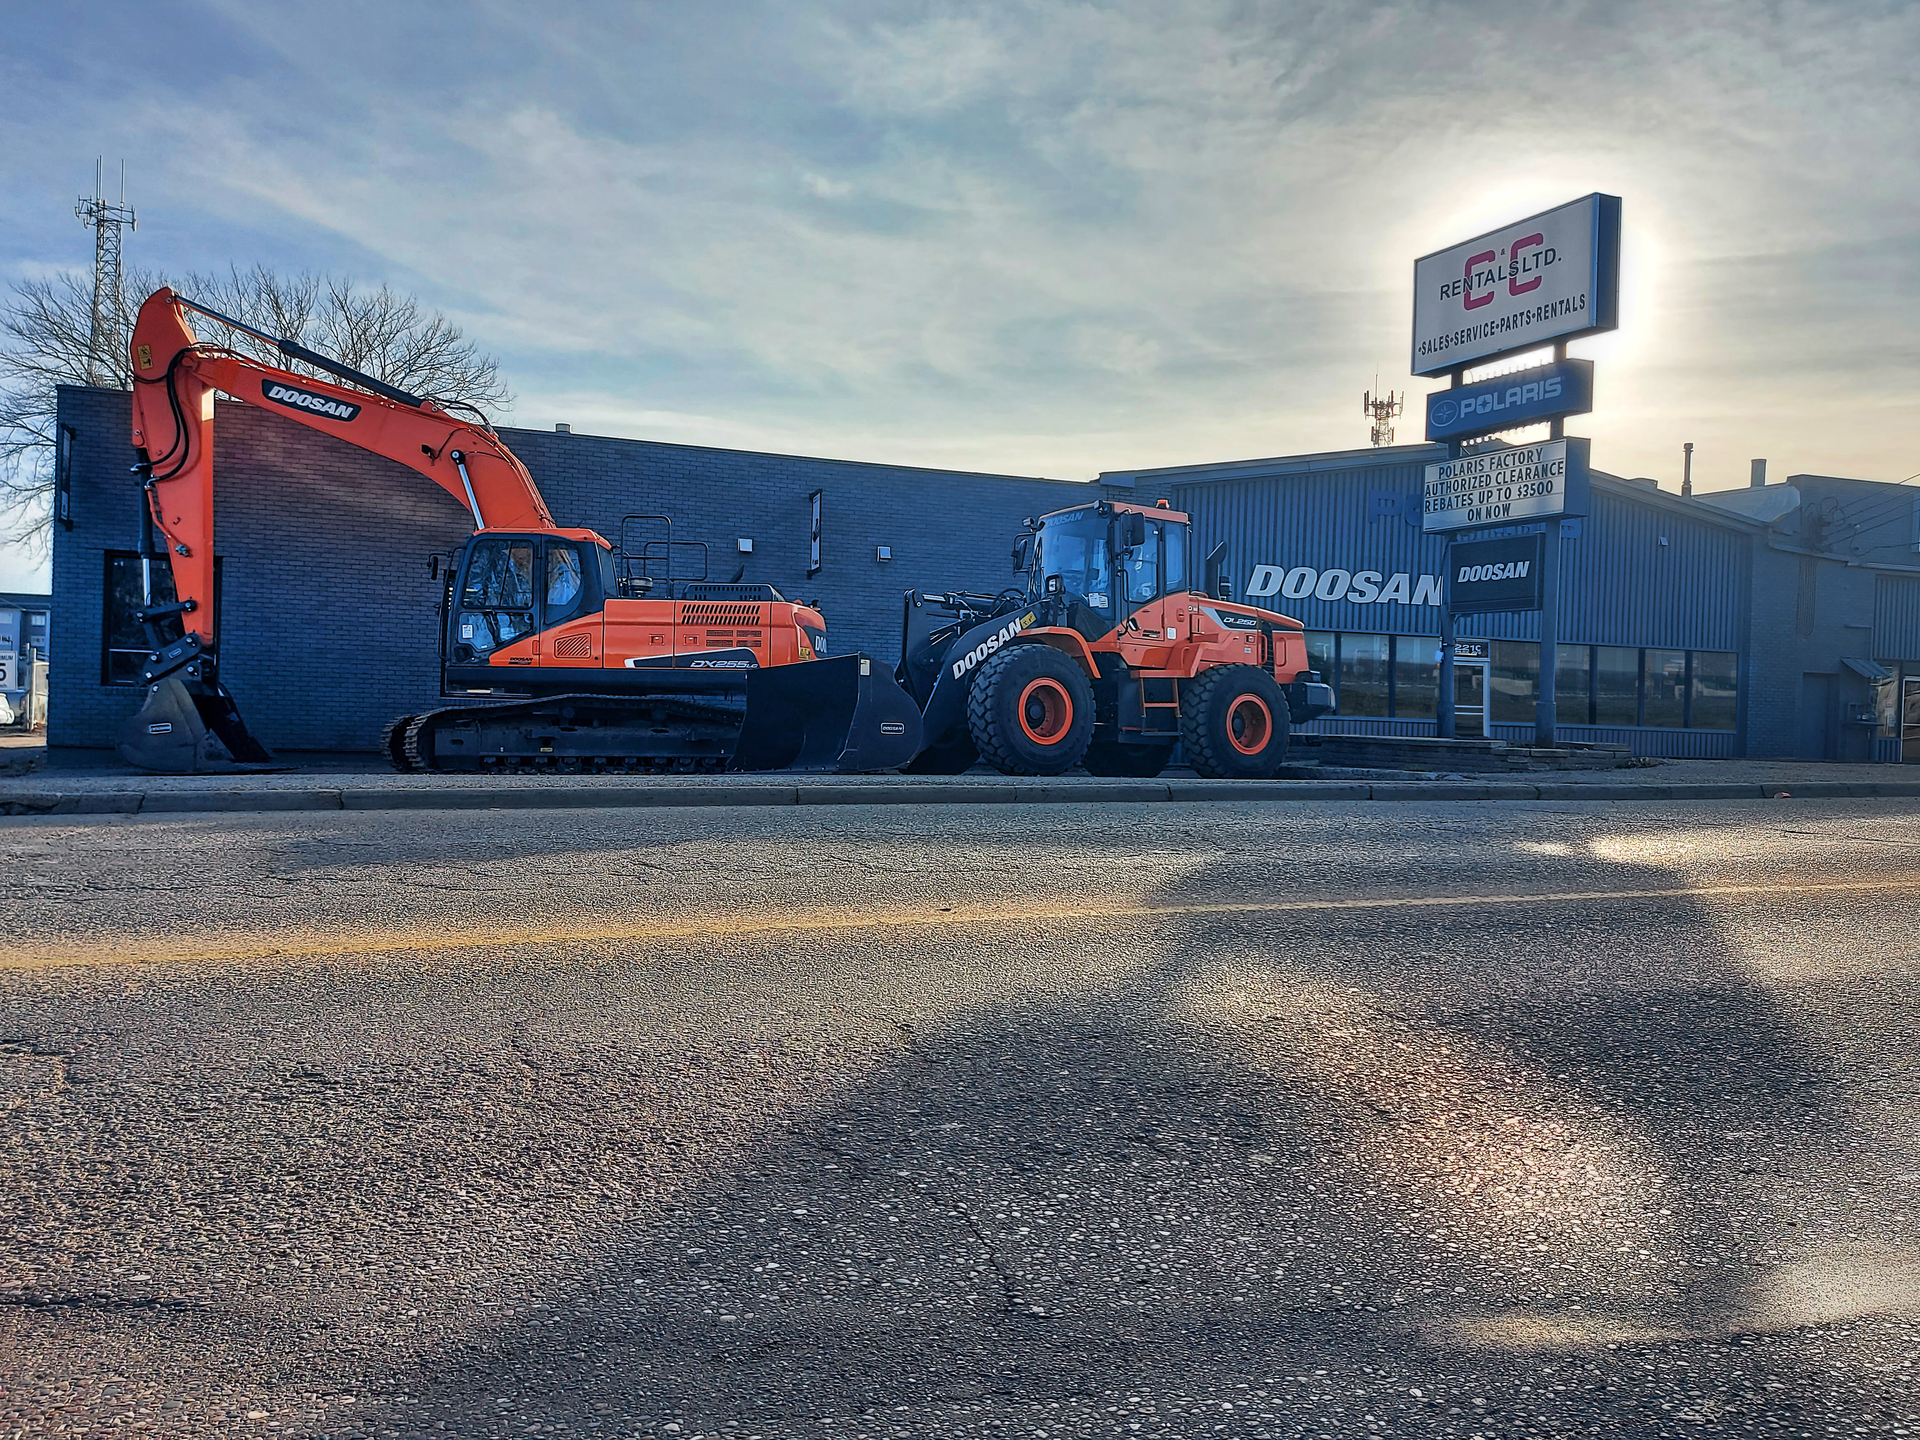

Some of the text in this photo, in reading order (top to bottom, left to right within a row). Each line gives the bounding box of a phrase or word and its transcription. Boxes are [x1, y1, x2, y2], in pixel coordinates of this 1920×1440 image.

[1439, 247, 1562, 301] RENTALS LTD.
[268, 385, 354, 418] DOOSAN
[1460, 376, 1562, 419] POLARIS
[1424, 460, 1564, 497] AUTHORIZED CLEARANCE
[1438, 447, 1543, 480] POLARIS FACTORY
[1424, 492, 1474, 513] REBATES
[1478, 490, 1494, 504] UP
[1496, 486, 1512, 501] TO
[1517, 480, 1553, 499] $3500
[1467, 502, 1511, 522] ON NOW
[1245, 563, 1443, 607] DOOSAN
[1457, 560, 1530, 584] DOOSAN
[1223, 616, 1257, 626] DL250
[952, 616, 1022, 680] DOOSAN
